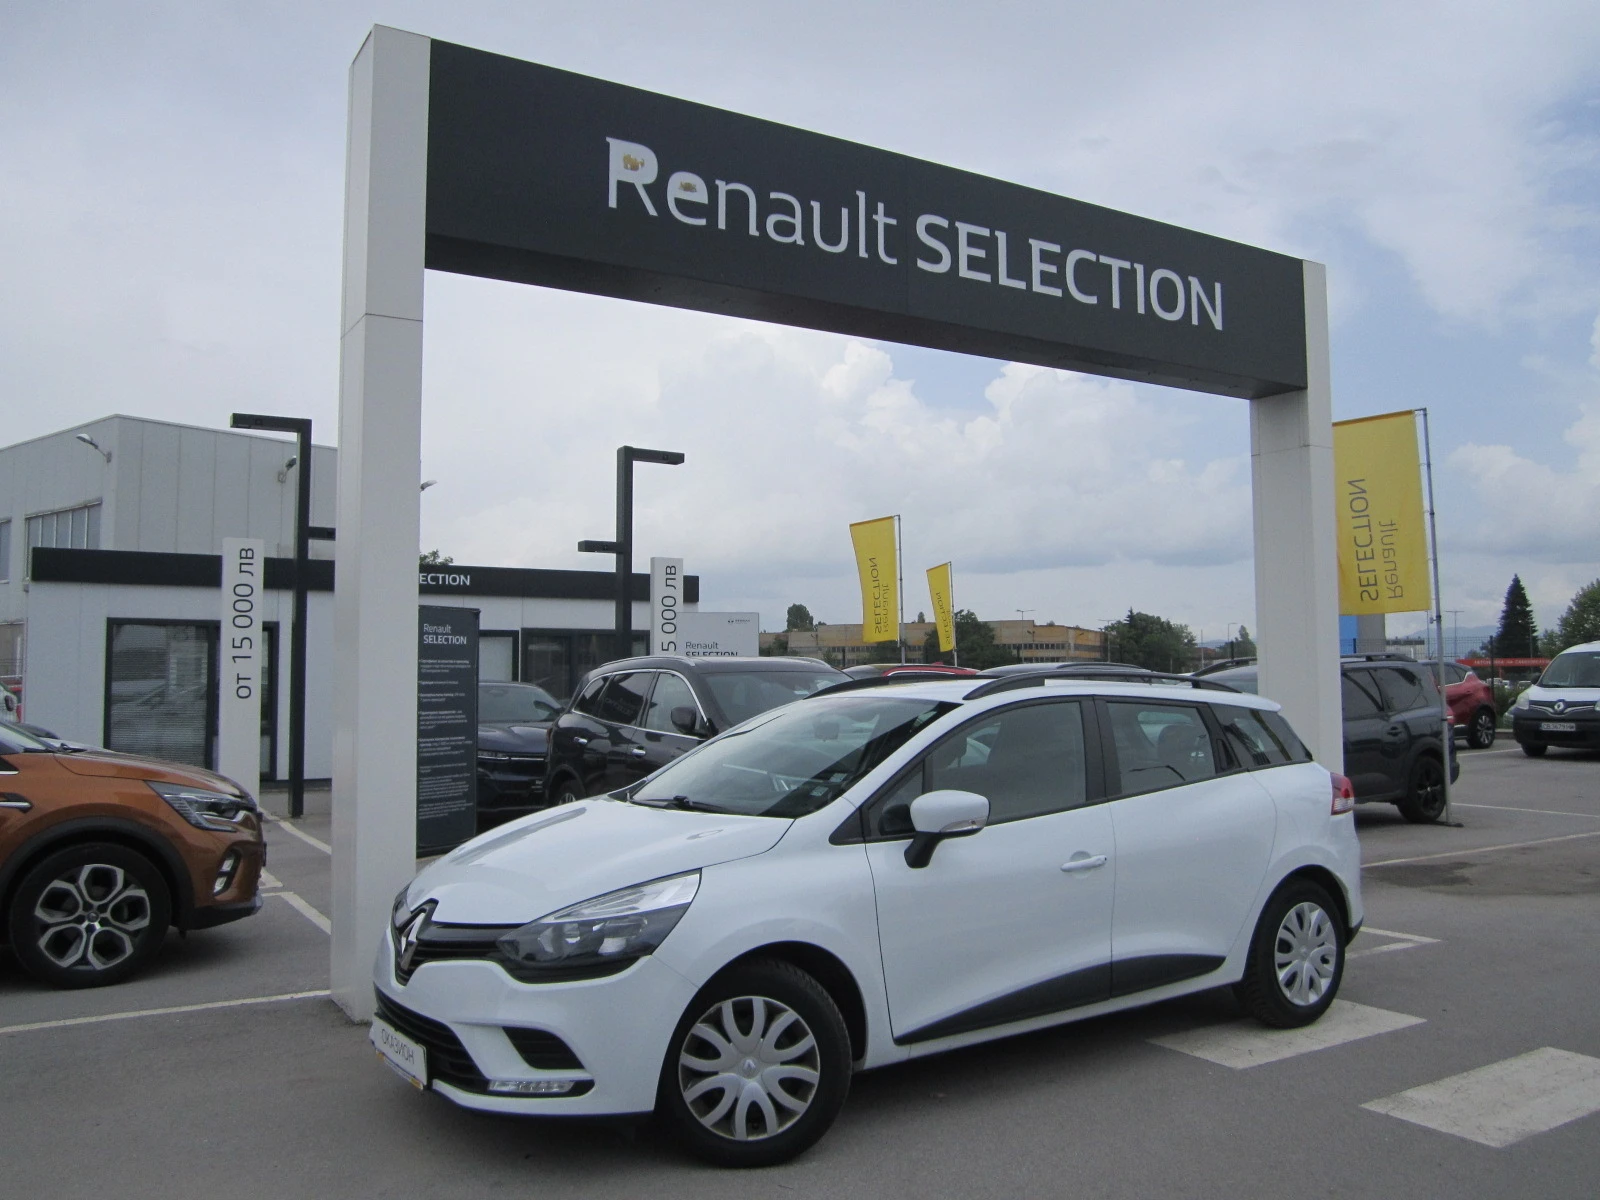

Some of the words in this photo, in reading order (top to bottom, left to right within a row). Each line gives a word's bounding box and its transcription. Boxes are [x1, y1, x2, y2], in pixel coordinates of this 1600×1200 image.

[606, 137, 898, 265] Renault
[916, 214, 1224, 331] SELECTION
[232, 583, 254, 629] 000
[661, 595, 677, 635] 000
[423, 623, 452, 634] Renault
[423, 634, 467, 645] SELECTION
[232, 637, 253, 663] 15
[685, 641, 719, 650] Renault
